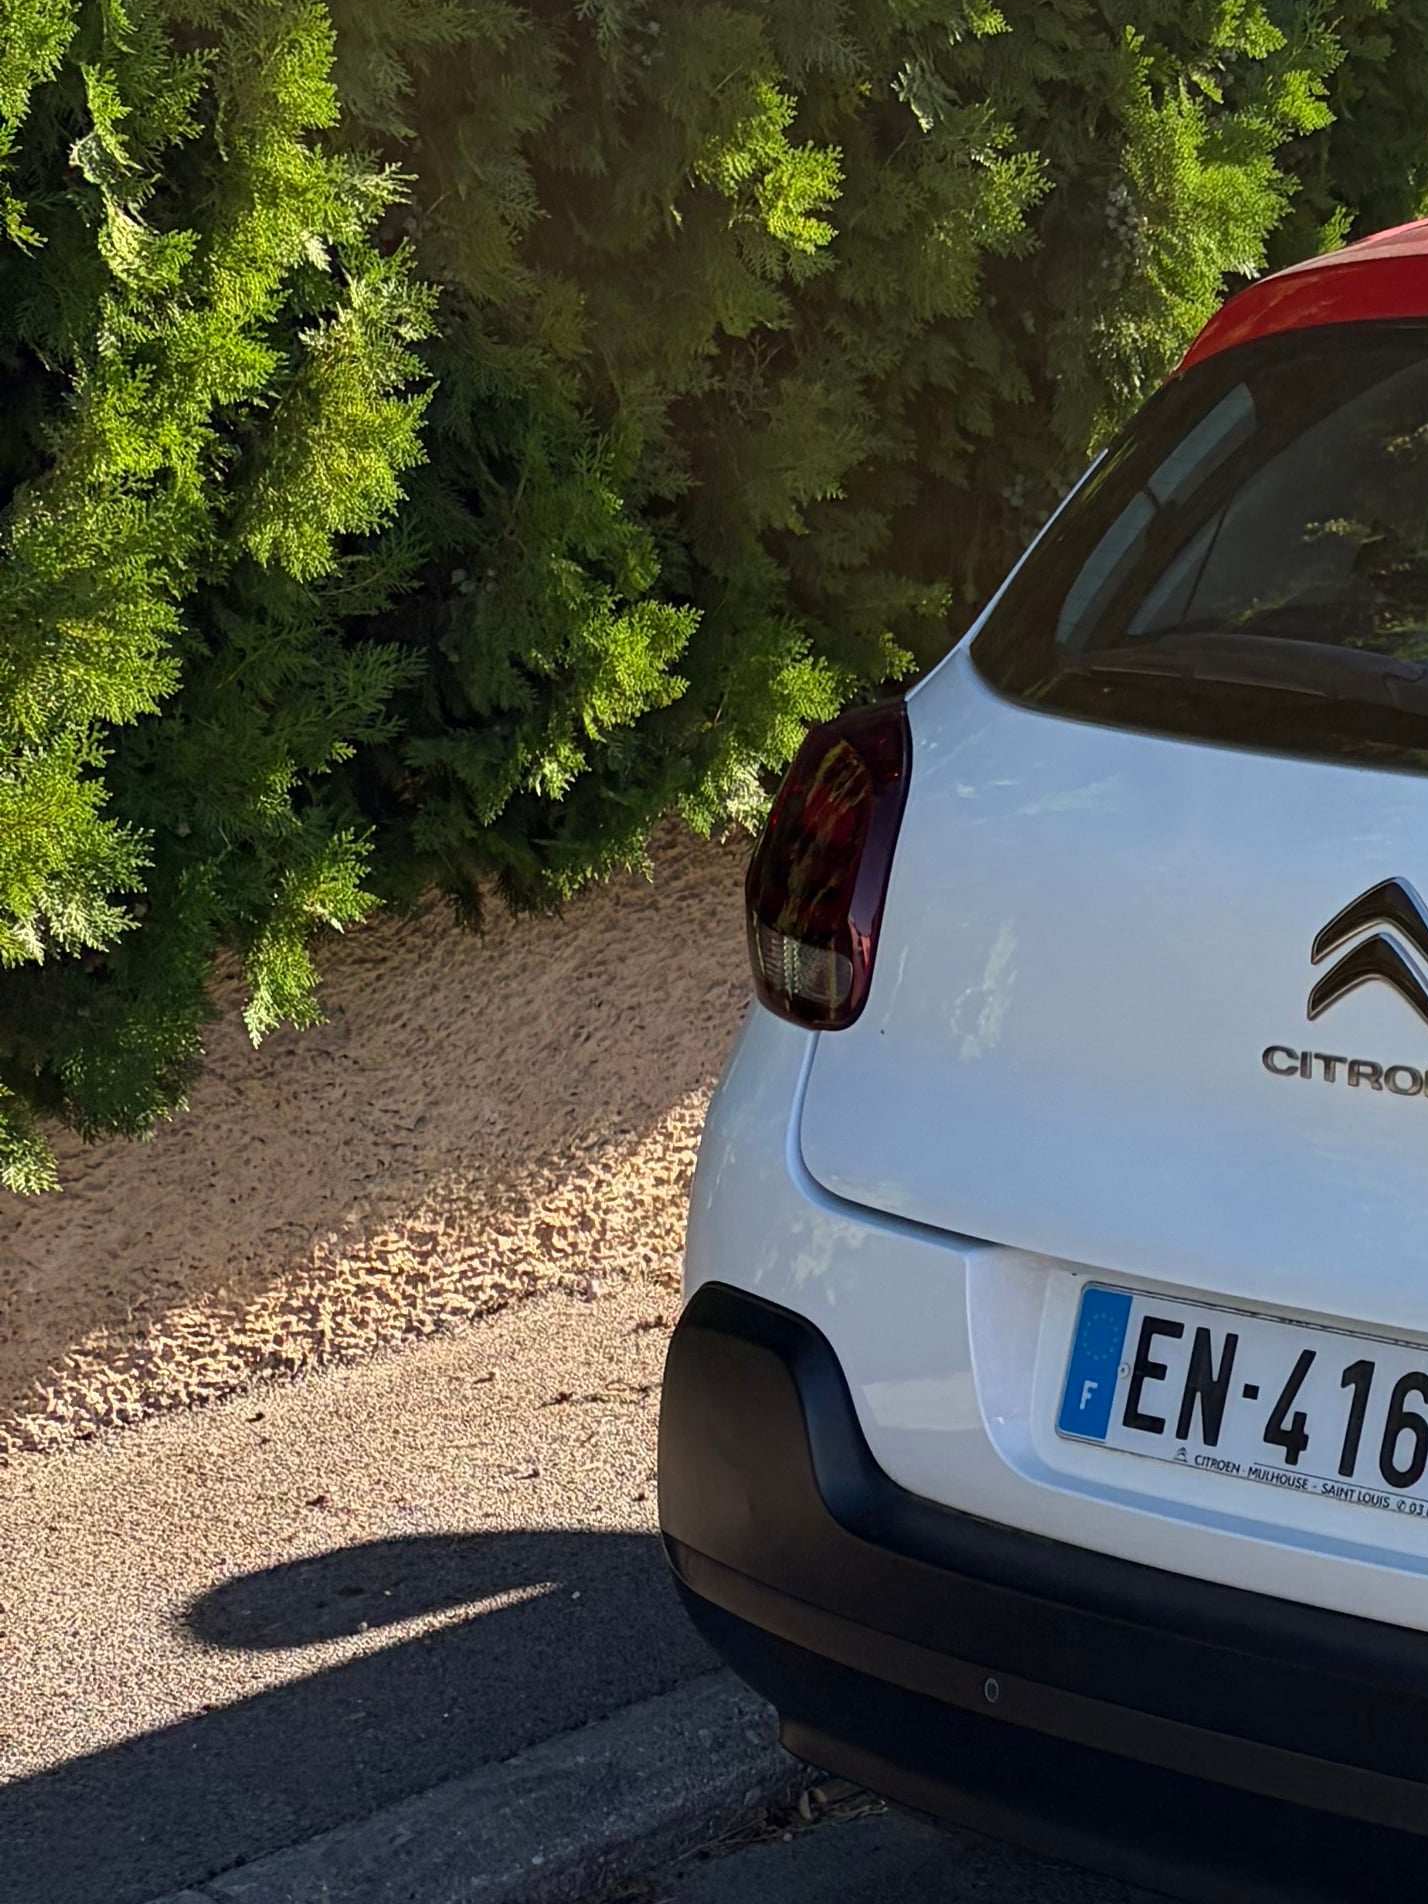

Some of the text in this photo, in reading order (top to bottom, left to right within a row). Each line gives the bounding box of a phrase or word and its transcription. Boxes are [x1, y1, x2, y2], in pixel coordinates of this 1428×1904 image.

[1079, 1380, 1099, 1410] F
[1194, 1454, 1241, 1475] CITROEN
[1248, 1466, 1309, 1490] MULHOUSE
[1320, 1482, 1358, 1503] SAINT
[1357, 1490, 1391, 1510] LOUIS
